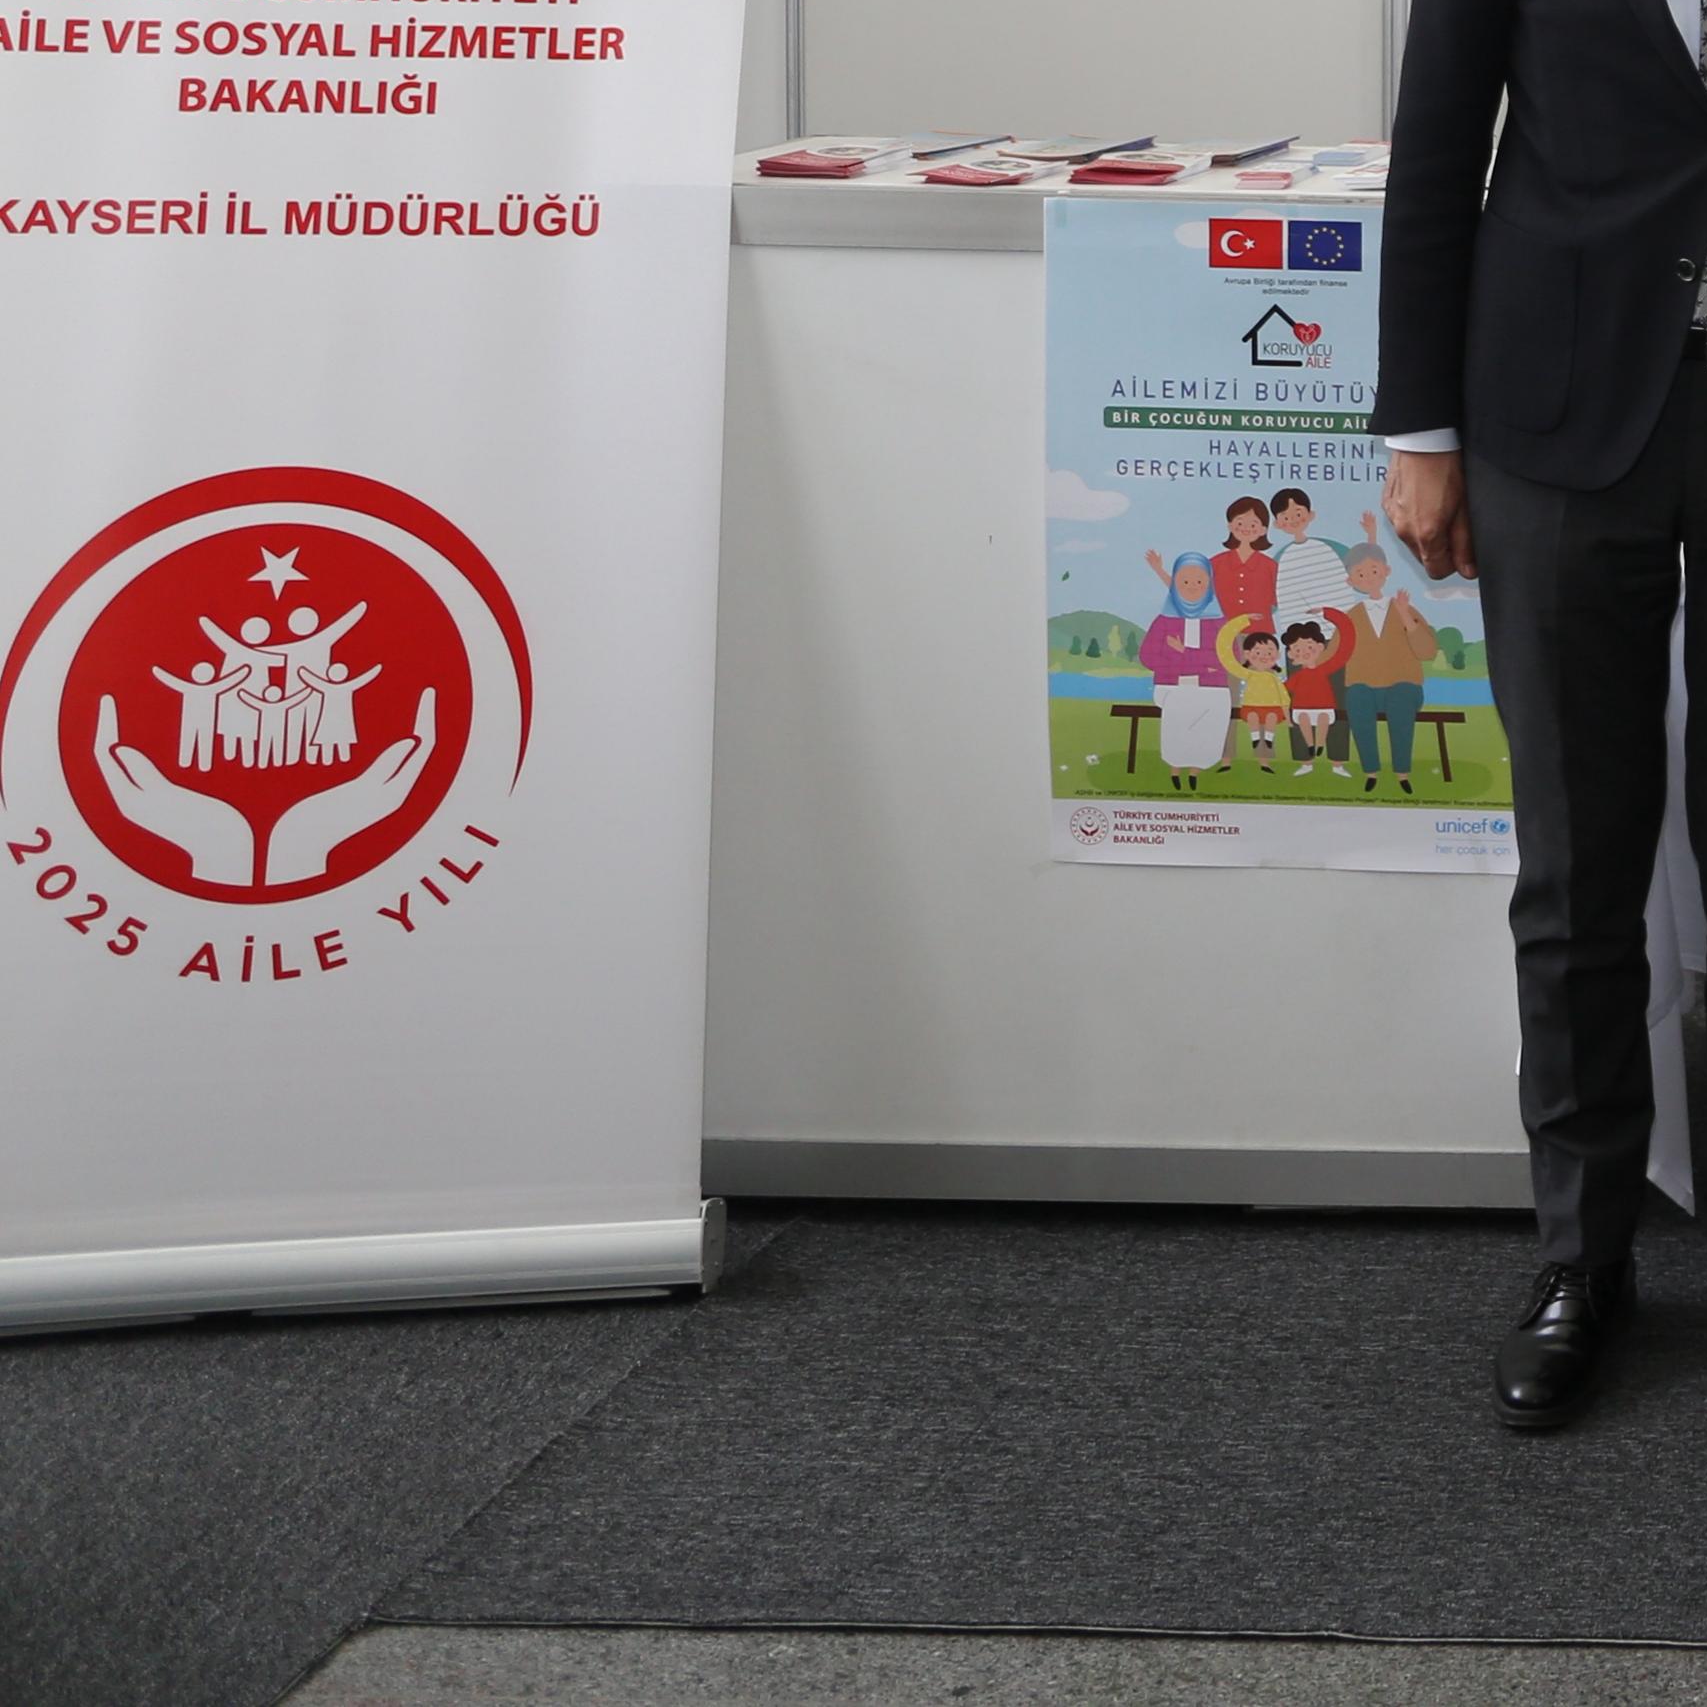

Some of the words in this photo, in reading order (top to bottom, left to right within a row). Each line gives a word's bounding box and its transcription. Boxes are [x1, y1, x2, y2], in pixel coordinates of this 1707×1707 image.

[0, 10, 90, 53] AİLE
[102, 20, 161, 55] VE
[174, 20, 356, 59] SOSYAL
[368, 17, 626, 62] HİZMETLER
[178, 74, 438, 116] BAKANLIĞI
[0, 192, 208, 236] KAYSERİ
[226, 191, 268, 236] İL
[284, 192, 601, 238] MÜDÜRLÜĞÜ
[1224, 277, 1251, 286] Avrupa
[1253, 278, 1276, 288] Birliği
[1277, 279, 1317, 288] tarafından
[1319, 280, 1348, 288] finanse
[1263, 343, 1333, 357] KORUYUCU
[1305, 356, 1332, 369] AİLE
[1111, 376, 1238, 401] AİLEMİZİ
[1112, 411, 1140, 424] BİR
[1149, 411, 1233, 427] ÇOCUĞUN
[1241, 414, 1334, 429] KORUYUCU
[1209, 440, 1375, 460] HAYALLERİNİ
[1116, 459, 1388, 484] GERÇEKLEŞTİREBİLİR
[1113, 809, 1152, 821] TÜRKİYE
[1154, 811, 1220, 822] CUMHURİYETİ
[1113, 823, 1134, 832] AİLE
[1135, 824, 1148, 832] VE
[1150, 825, 1186, 834] SOSYAL
[1187, 825, 1240, 835] HİZMETLER
[1435, 818, 1488, 834] unicef
[1113, 834, 1165, 845] BAKANLIĞI
[6, 826, 148, 959] 2025
[179, 929, 349, 983] AİLE
[378, 823, 500, 935] YILI
